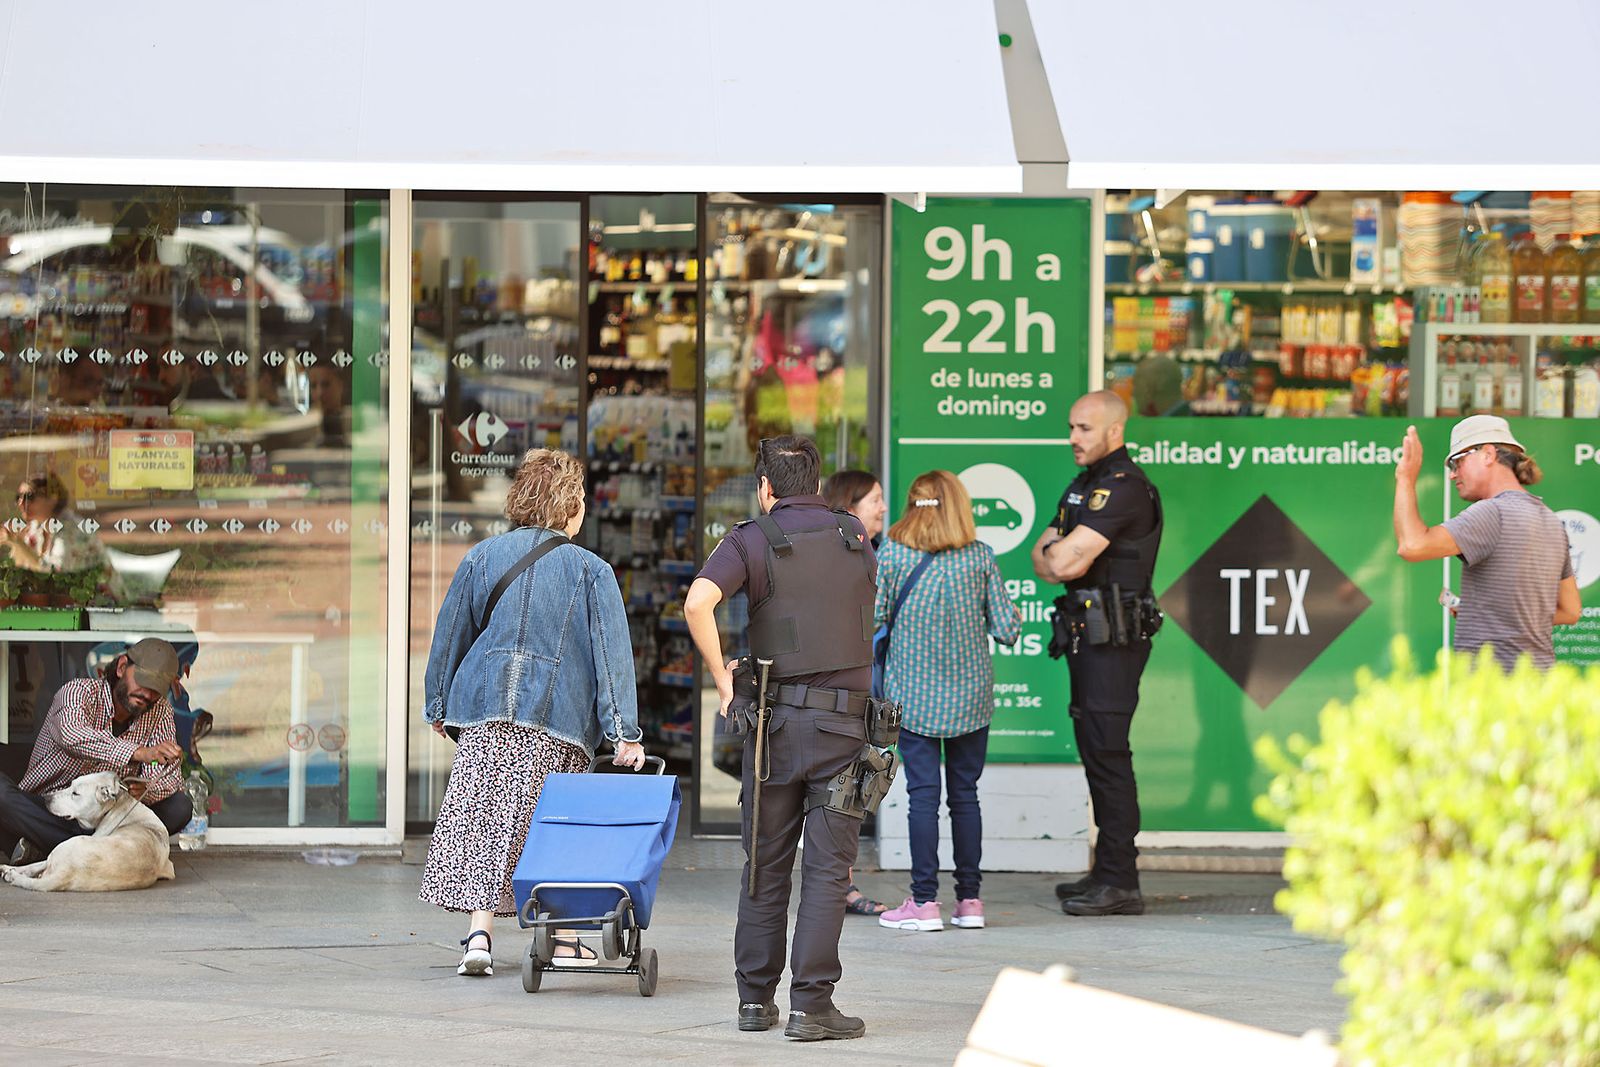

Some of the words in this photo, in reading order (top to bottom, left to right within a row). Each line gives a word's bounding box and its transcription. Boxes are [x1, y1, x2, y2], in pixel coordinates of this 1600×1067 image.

[924, 224, 1012, 281] 9h
[1036, 253, 1061, 281] a
[922, 297, 1056, 353] 22h
[931, 368, 961, 388] de
[968, 368, 1033, 388] lunes
[1039, 373, 1053, 388] a
[937, 395, 1047, 420] domingo
[127, 450, 179, 459] PLANTAS
[451, 451, 515, 464] Carrefour
[1228, 447, 1246, 469] y
[118, 461, 186, 470] NATURALES
[460, 467, 506, 478] express
[1004, 579, 1037, 600] ga
[1220, 568, 1311, 635] TEX
